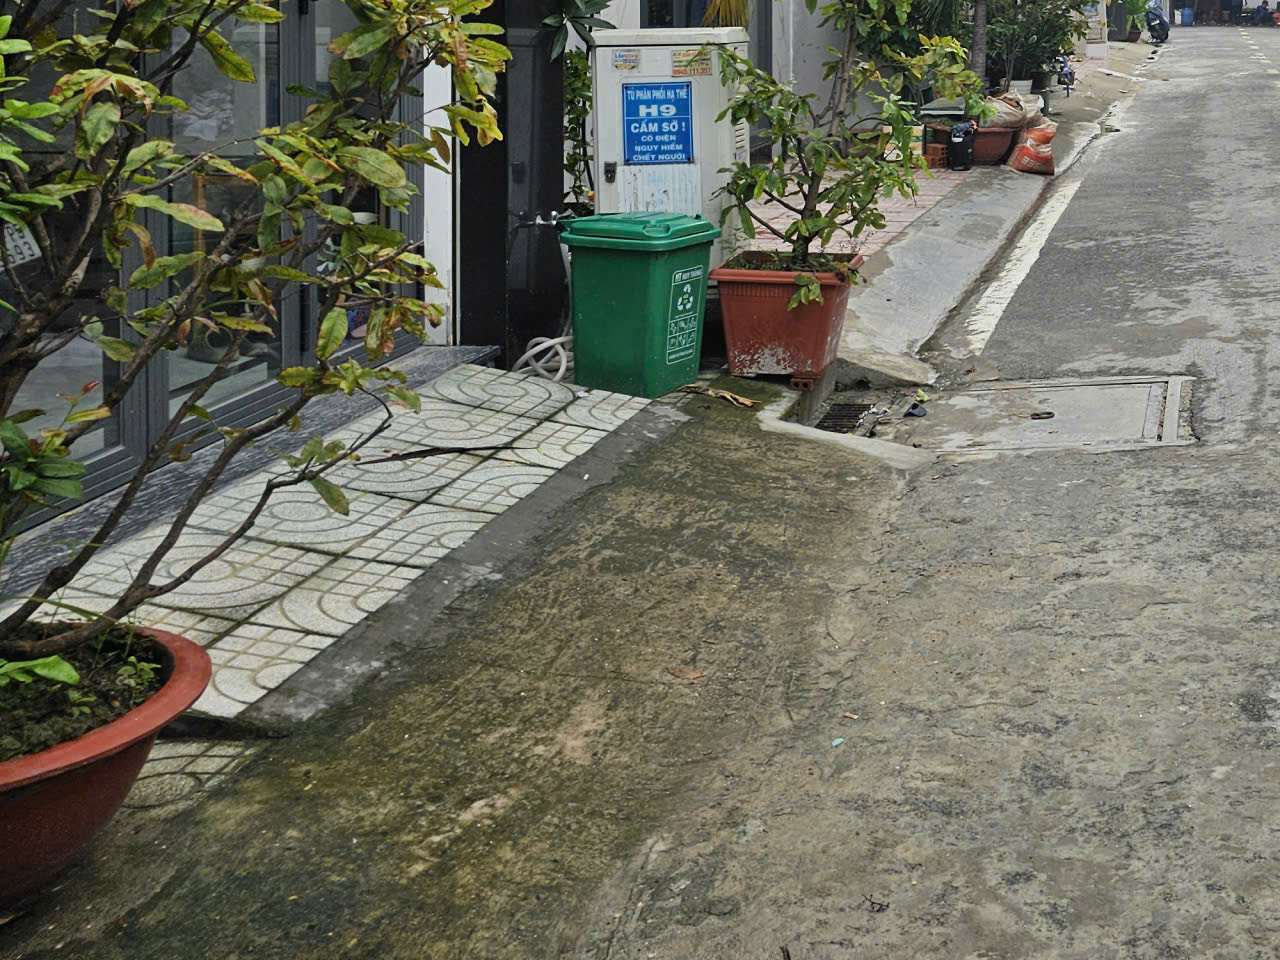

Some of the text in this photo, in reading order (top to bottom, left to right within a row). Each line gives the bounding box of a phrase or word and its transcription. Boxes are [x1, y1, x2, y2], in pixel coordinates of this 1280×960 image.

[636, 88, 651, 100] PHÂN
[639, 104, 677, 117] H9
[631, 118, 658, 133] CẤM
[655, 133, 676, 143] ĐIỆN
[633, 153, 656, 161] CHẾT
